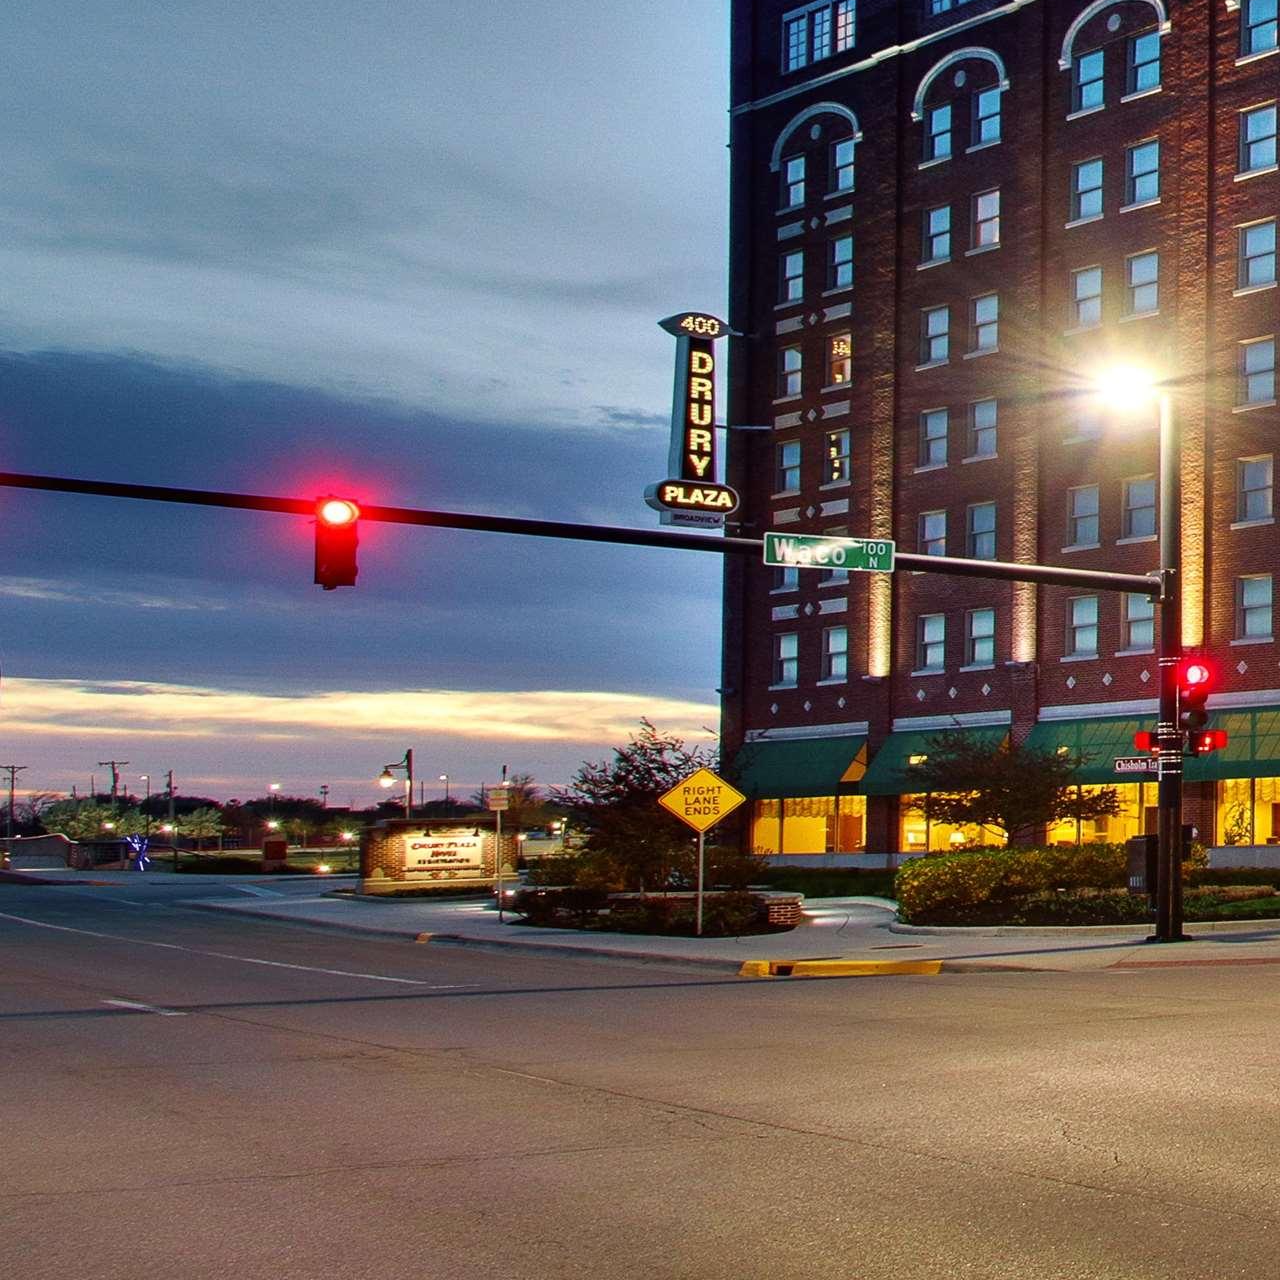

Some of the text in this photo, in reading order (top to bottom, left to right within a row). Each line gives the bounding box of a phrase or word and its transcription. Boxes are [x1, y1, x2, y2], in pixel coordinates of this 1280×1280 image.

[681, 316, 720, 335] 400
[690, 351, 713, 477] DRURY
[664, 486, 733, 507] PLAZA
[773, 538, 847, 565] Waco
[862, 542, 886, 556] 100
[868, 557, 879, 569] N
[1115, 759, 1147, 770] Chisholm
[682, 786, 722, 796] RIGHT
[684, 796, 720, 805] LANE
[684, 806, 720, 816] ENDS
